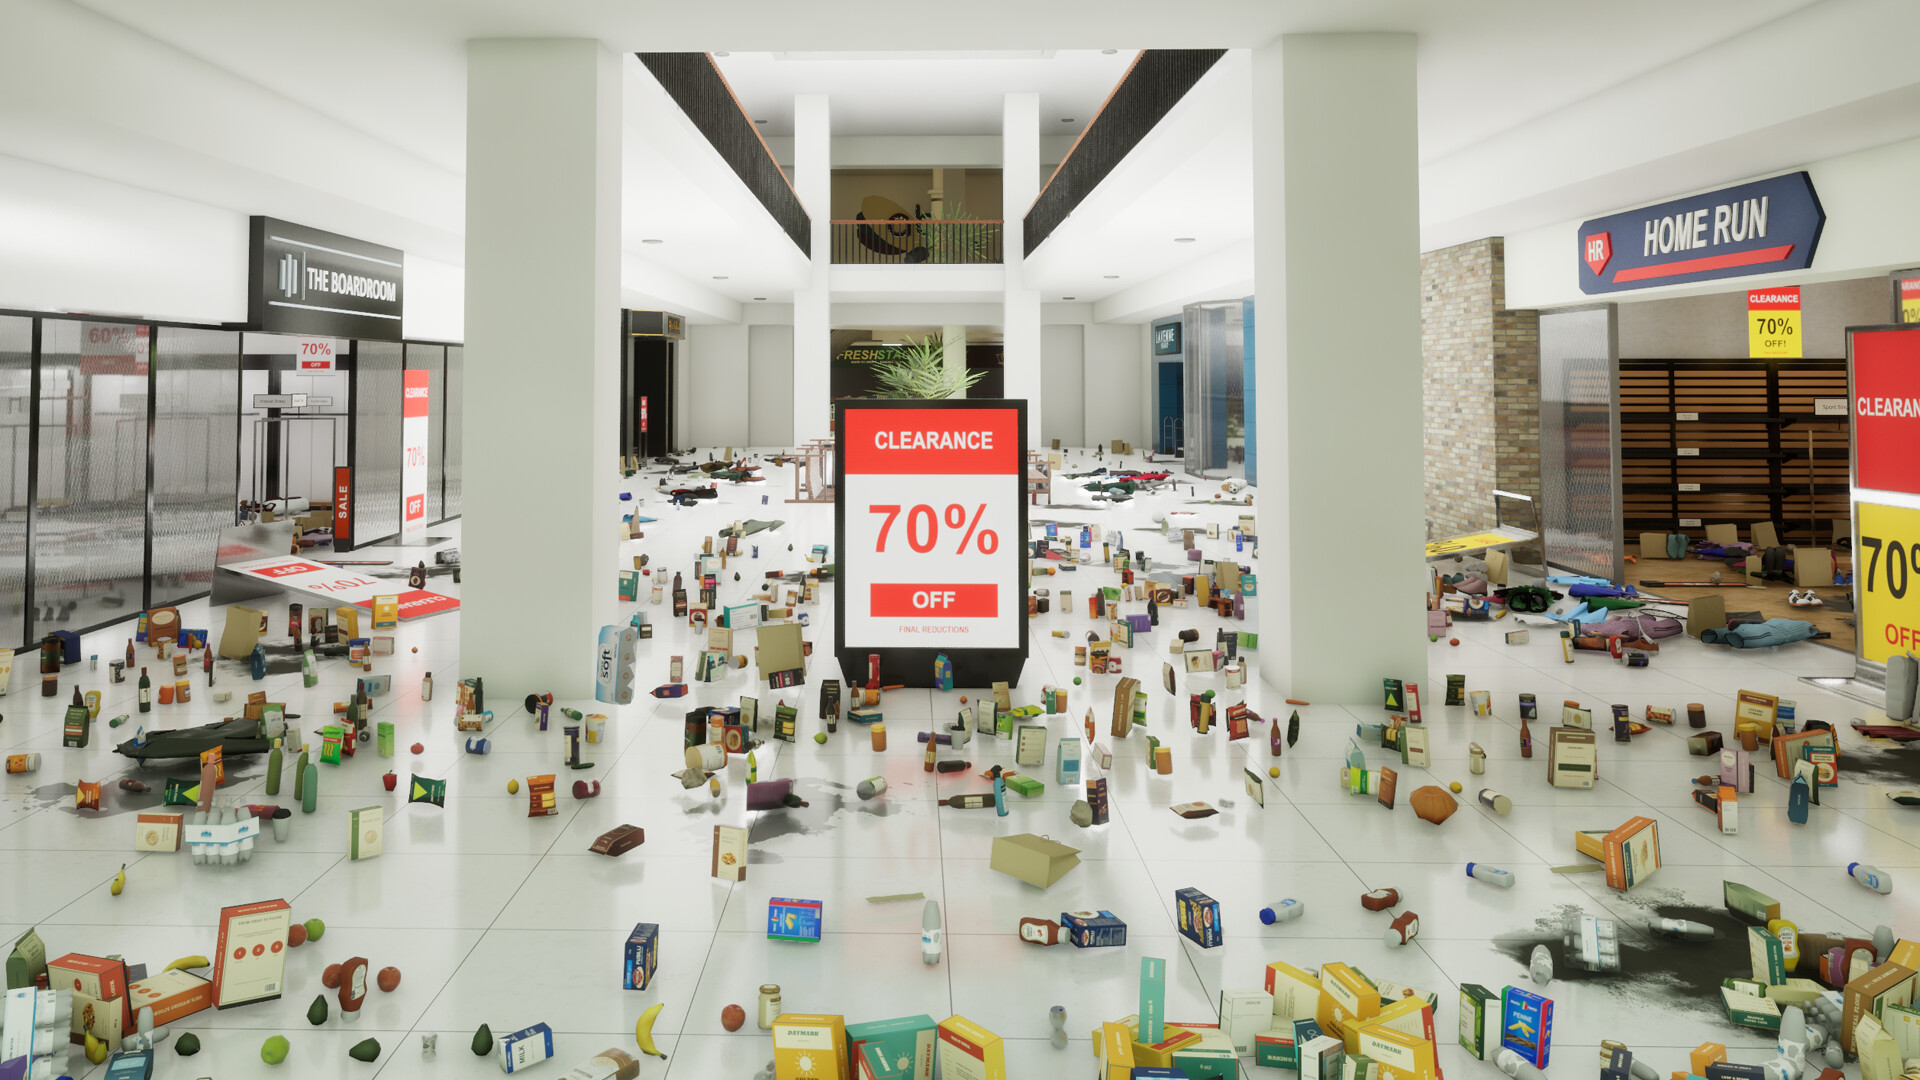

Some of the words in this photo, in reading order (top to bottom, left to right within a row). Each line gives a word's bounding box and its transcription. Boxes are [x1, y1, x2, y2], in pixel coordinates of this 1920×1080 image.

[1643, 208, 1709, 257] HOME
[1713, 196, 1769, 246] RUN
[1588, 239, 1605, 262] HR
[307, 267, 329, 292] THE
[331, 271, 396, 302] BOARDROOM
[1749, 294, 1799, 304] CLEARANCE
[1757, 317, 1793, 335] 70%
[301, 343, 331, 355] 70%
[1765, 340, 1787, 348] OFF!
[1857, 396, 1920, 418] CLEARAN
[874, 431, 994, 450] CLEARANCE
[407, 445, 425, 468] 70%
[338, 486, 348, 519] SALE
[409, 500, 421, 515] OFF
[868, 503, 999, 555] 70%
[272, 565, 308, 576] OFF
[308, 577, 377, 593] 70%
[397, 595, 447, 610] CLEARAN
[912, 590, 956, 609] OFF
[922, 625, 970, 633] REDUCTIONS
[602, 648, 612, 679] soft
[787, 1029, 820, 1037] DAYMARK
[1371, 1040, 1403, 1056] DAYMARK
[1267, 1054, 1291, 1063] BAKING
